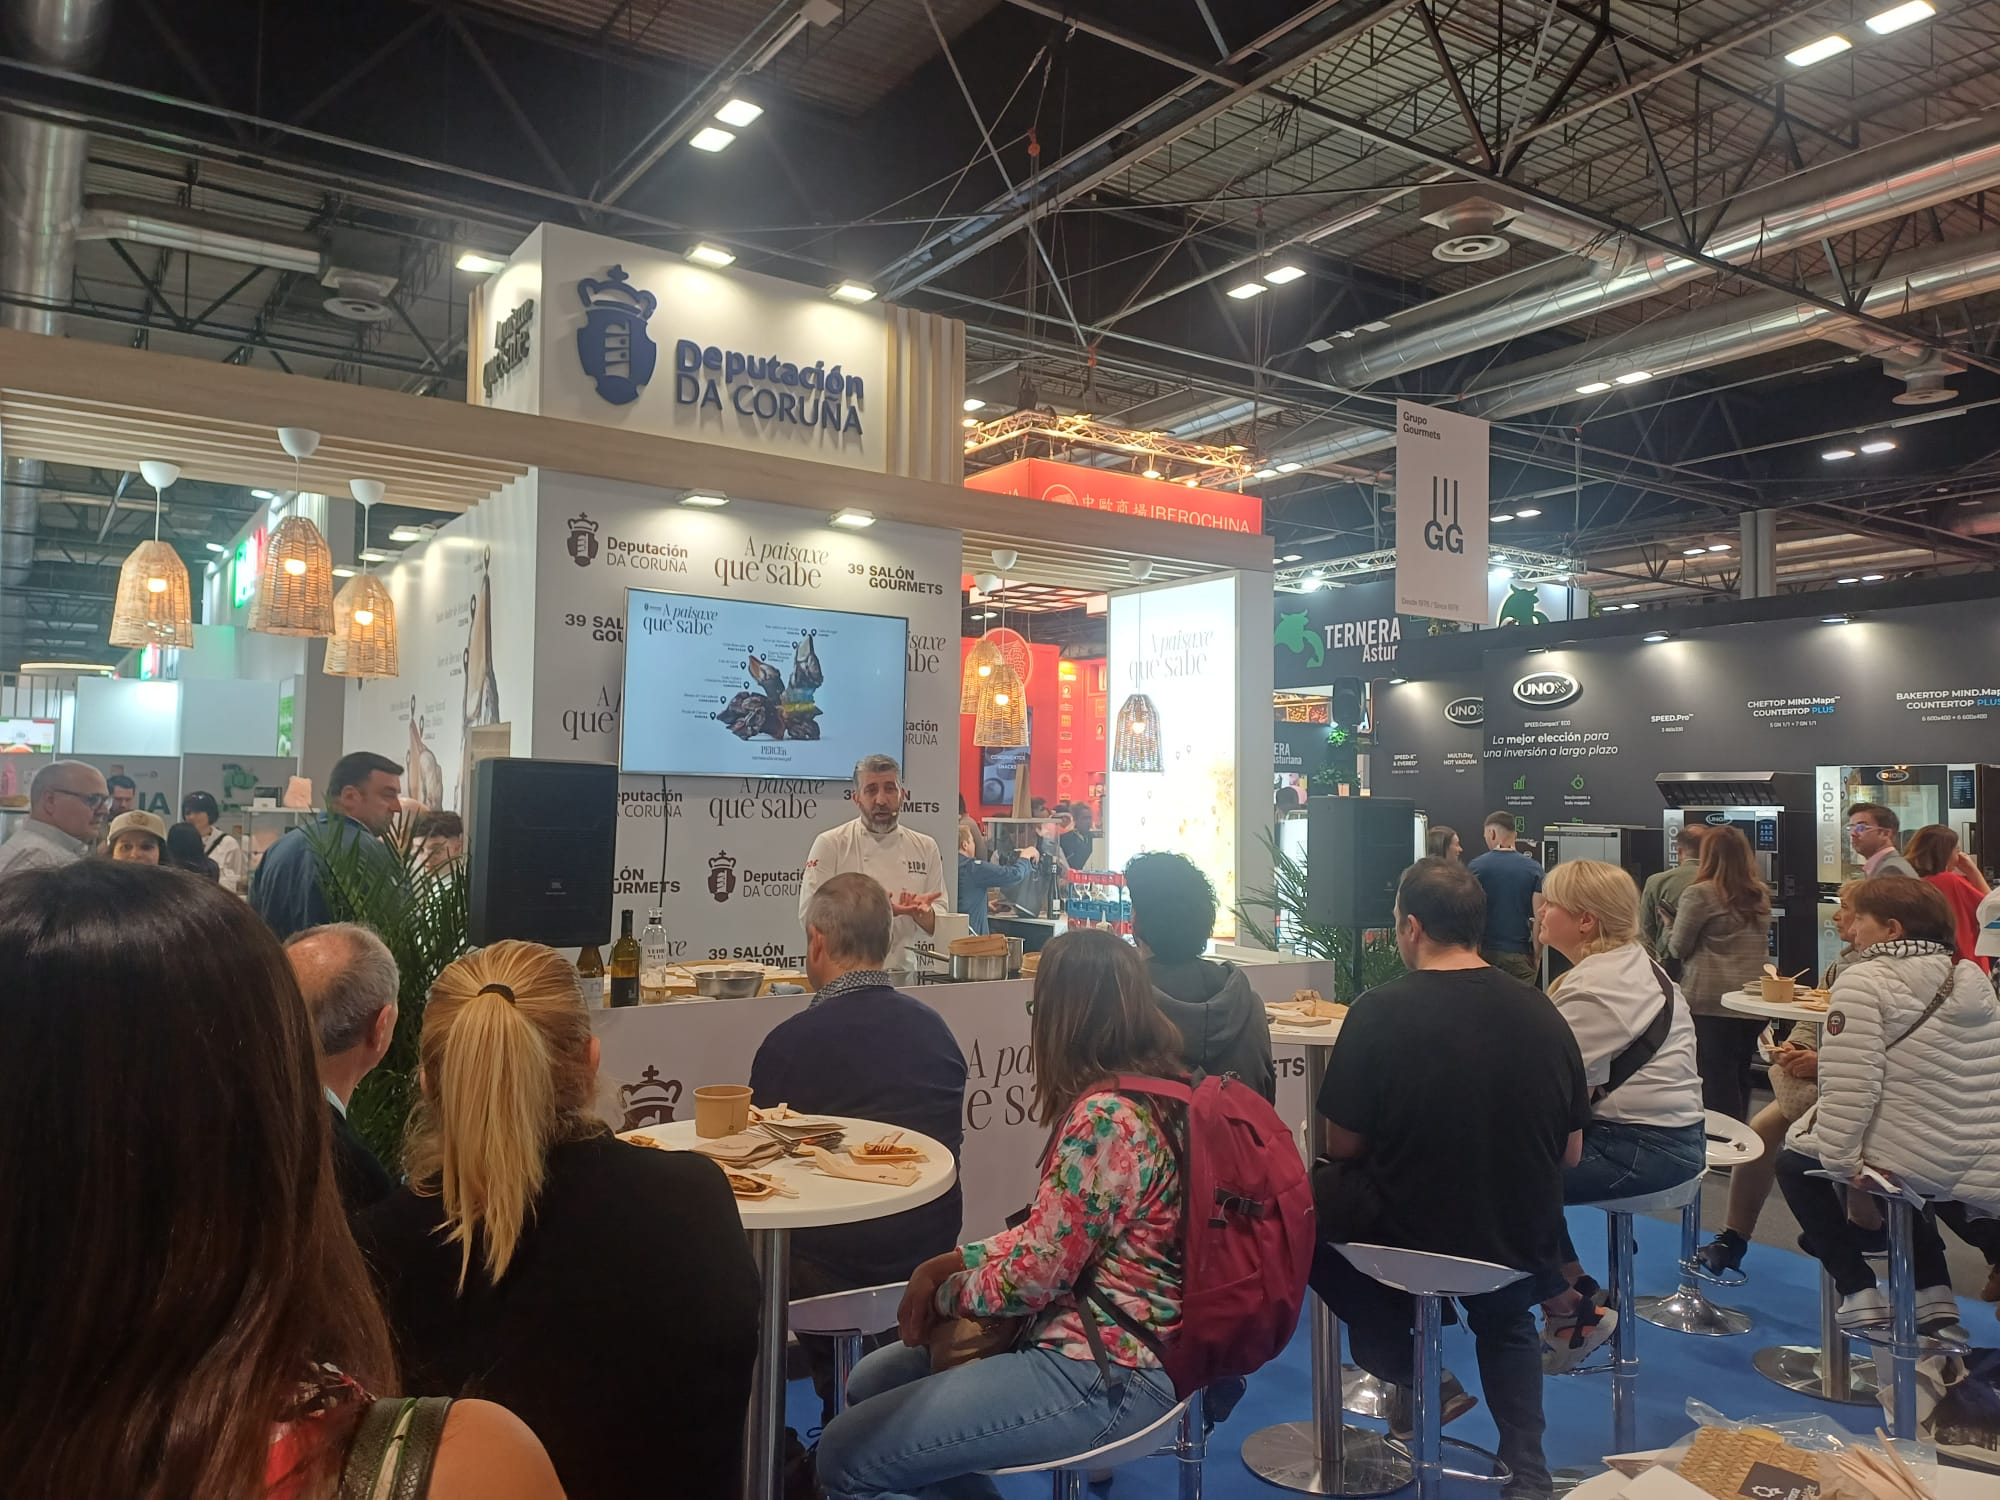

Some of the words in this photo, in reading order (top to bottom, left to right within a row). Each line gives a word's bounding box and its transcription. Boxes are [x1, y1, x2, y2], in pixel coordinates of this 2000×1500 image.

[676, 339, 864, 400] Deputación
[677, 373, 723, 411] DA
[733, 384, 864, 435] CORUÑA
[1403, 411, 1428, 426] Grupo
[1403, 423, 1441, 440] Gourmets
[1150, 504, 1251, 534] IBEROCHINA
[607, 536, 689, 559] Deputación
[743, 536, 755, 556] A
[760, 542, 830, 565] paisaxe
[606, 552, 626, 568] DA
[630, 555, 688, 574] CORUÑA
[848, 563, 865, 575] 39
[869, 565, 915, 581] SALÓN
[714, 556, 760, 588] que
[765, 561, 822, 589] sabe
[869, 577, 944, 595] GOURMETS
[565, 613, 587, 627] 39
[663, 603, 671, 616] A
[672, 606, 719, 621] paisaxe
[643, 616, 673, 635] que
[676, 618, 713, 636] sabe
[1324, 617, 1401, 649] TERNERA
[1362, 643, 1398, 663] Astur
[1129, 658, 1160, 689] que
[1165, 649, 1207, 678] sabe
[598, 685, 610, 707] A
[1747, 699, 1786, 708] CHEFTOP
[1896, 690, 1949, 700] BAKERTOP
[1753, 707, 1811, 717] COUNTERTOP
[1811, 705, 1835, 714] PLUS
[1906, 699, 1975, 710] COUNTERTOP
[562, 708, 614, 741] que
[1492, 735, 1504, 745] La
[1506, 733, 1536, 746] mejor
[1538, 731, 1581, 743] elección
[1583, 732, 1610, 744] para
[1484, 750, 1502, 758] una
[1503, 746, 1548, 758] inversión
[1550, 748, 1557, 756] a
[1559, 745, 1587, 758] largo
[1588, 744, 1619, 757] plazo
[624, 802, 683, 818] CORUÑA
[709, 796, 755, 827] que
[761, 794, 817, 820] sabe
[900, 802, 940, 813] METS
[743, 885, 761, 898] DA
[763, 884, 801, 897] CORU
[708, 949, 728, 960] 39
[733, 942, 784, 959] SALÓN
[967, 1038, 988, 1080] A
